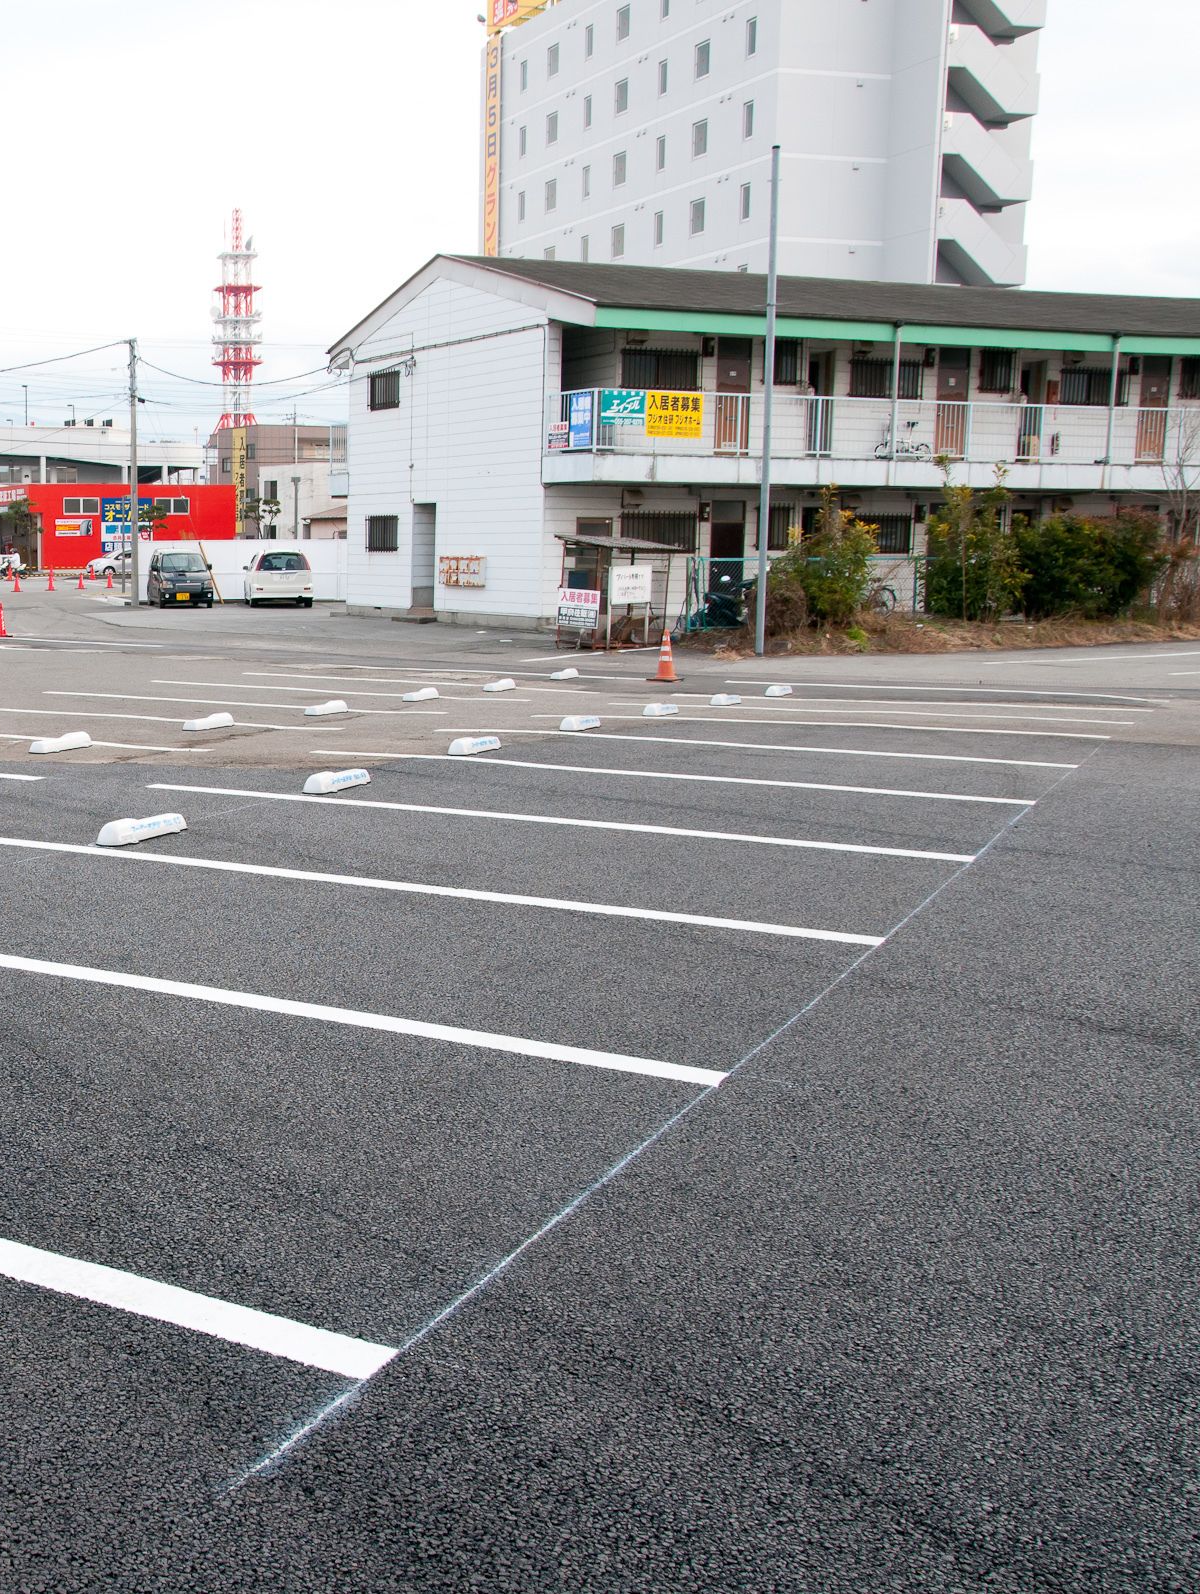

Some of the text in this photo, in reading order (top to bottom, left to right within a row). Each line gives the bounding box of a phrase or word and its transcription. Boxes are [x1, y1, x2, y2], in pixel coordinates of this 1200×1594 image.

[648, 395, 701, 413] 入居者募集
[561, 591, 598, 604] 入居者募集
